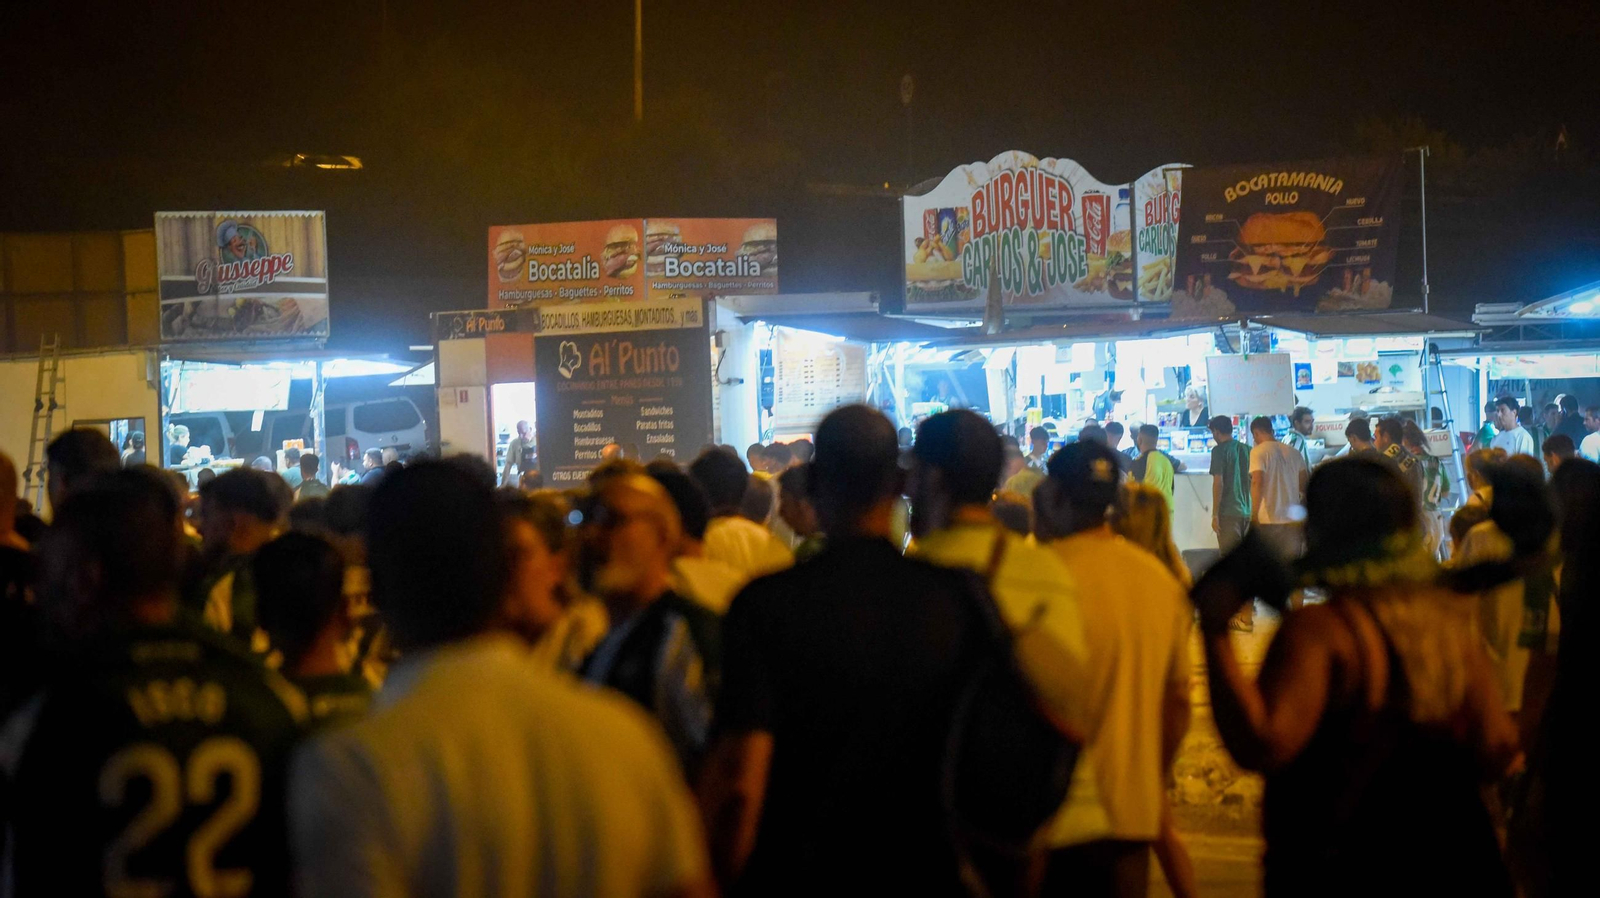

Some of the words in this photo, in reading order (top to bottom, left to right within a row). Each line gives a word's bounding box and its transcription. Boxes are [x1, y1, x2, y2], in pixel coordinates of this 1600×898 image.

[1224, 172, 1343, 203] BOCATAMANIA
[972, 167, 1075, 238] BURGUER
[1265, 192, 1299, 205] POLLO
[528, 244, 552, 255] Mónica
[553, 245, 558, 256] y
[559, 243, 576, 254] José
[664, 243, 697, 254] Mónica
[700, 245, 705, 255] y
[707, 243, 727, 254] José
[528, 255, 600, 281] Bocatalia
[665, 256, 761, 277] Bocatalia
[962, 226, 1025, 295] CARLOS
[1027, 229, 1044, 296] &
[1047, 230, 1088, 286] JOSE
[498, 289, 553, 301] Hamburguesas
[559, 286, 598, 299] Baguettes
[603, 284, 634, 295] Perritos
[652, 281, 703, 290] Hamburguesas
[708, 281, 742, 290] Baguettes
[1315, 423, 1343, 432] POLVILLO
[1428, 434, 1448, 442] VILLO
[552, 470, 571, 481] OTROS
[572, 469, 592, 480] EVENT
[97, 735, 263, 898] 22
